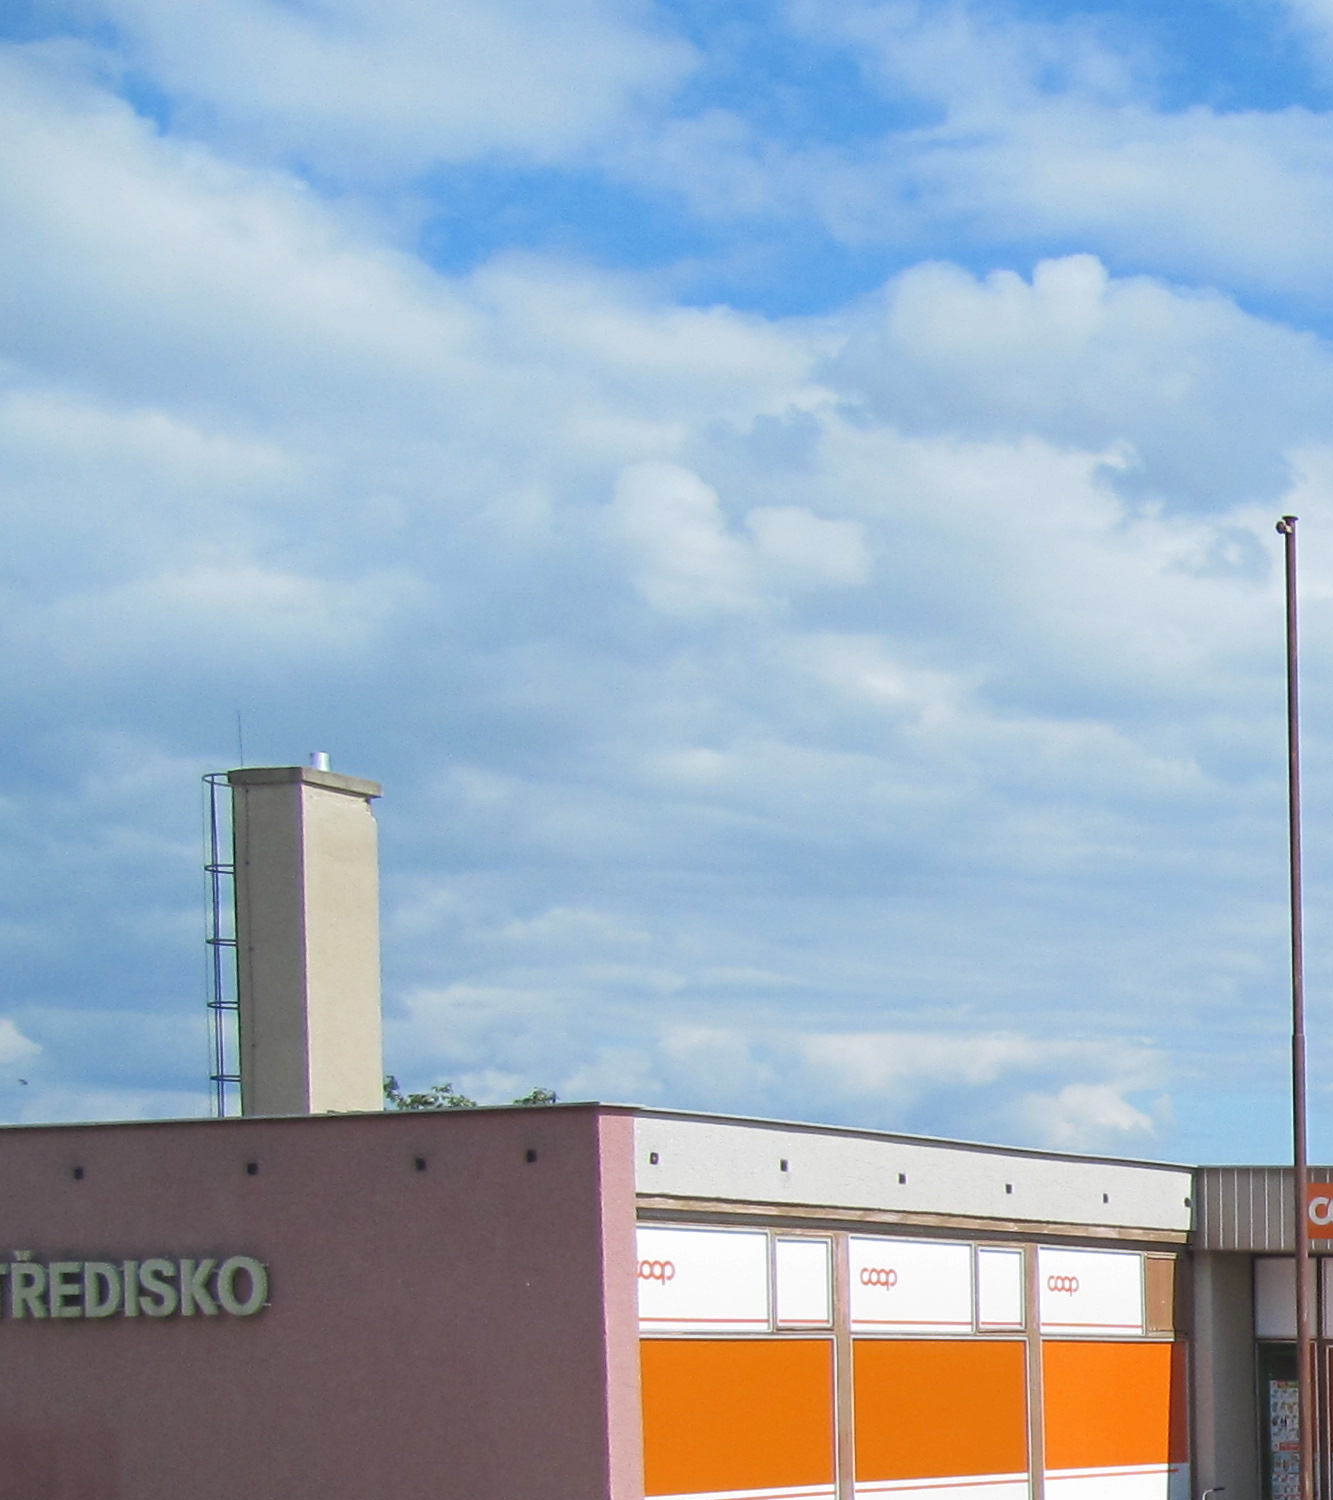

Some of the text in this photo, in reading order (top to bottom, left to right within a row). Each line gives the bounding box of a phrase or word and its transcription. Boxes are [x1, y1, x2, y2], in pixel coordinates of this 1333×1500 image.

[0, 1249, 269, 1318] ŘEDISKO
[860, 1267, 898, 1291] coop
[1047, 1275, 1080, 1297] coop
